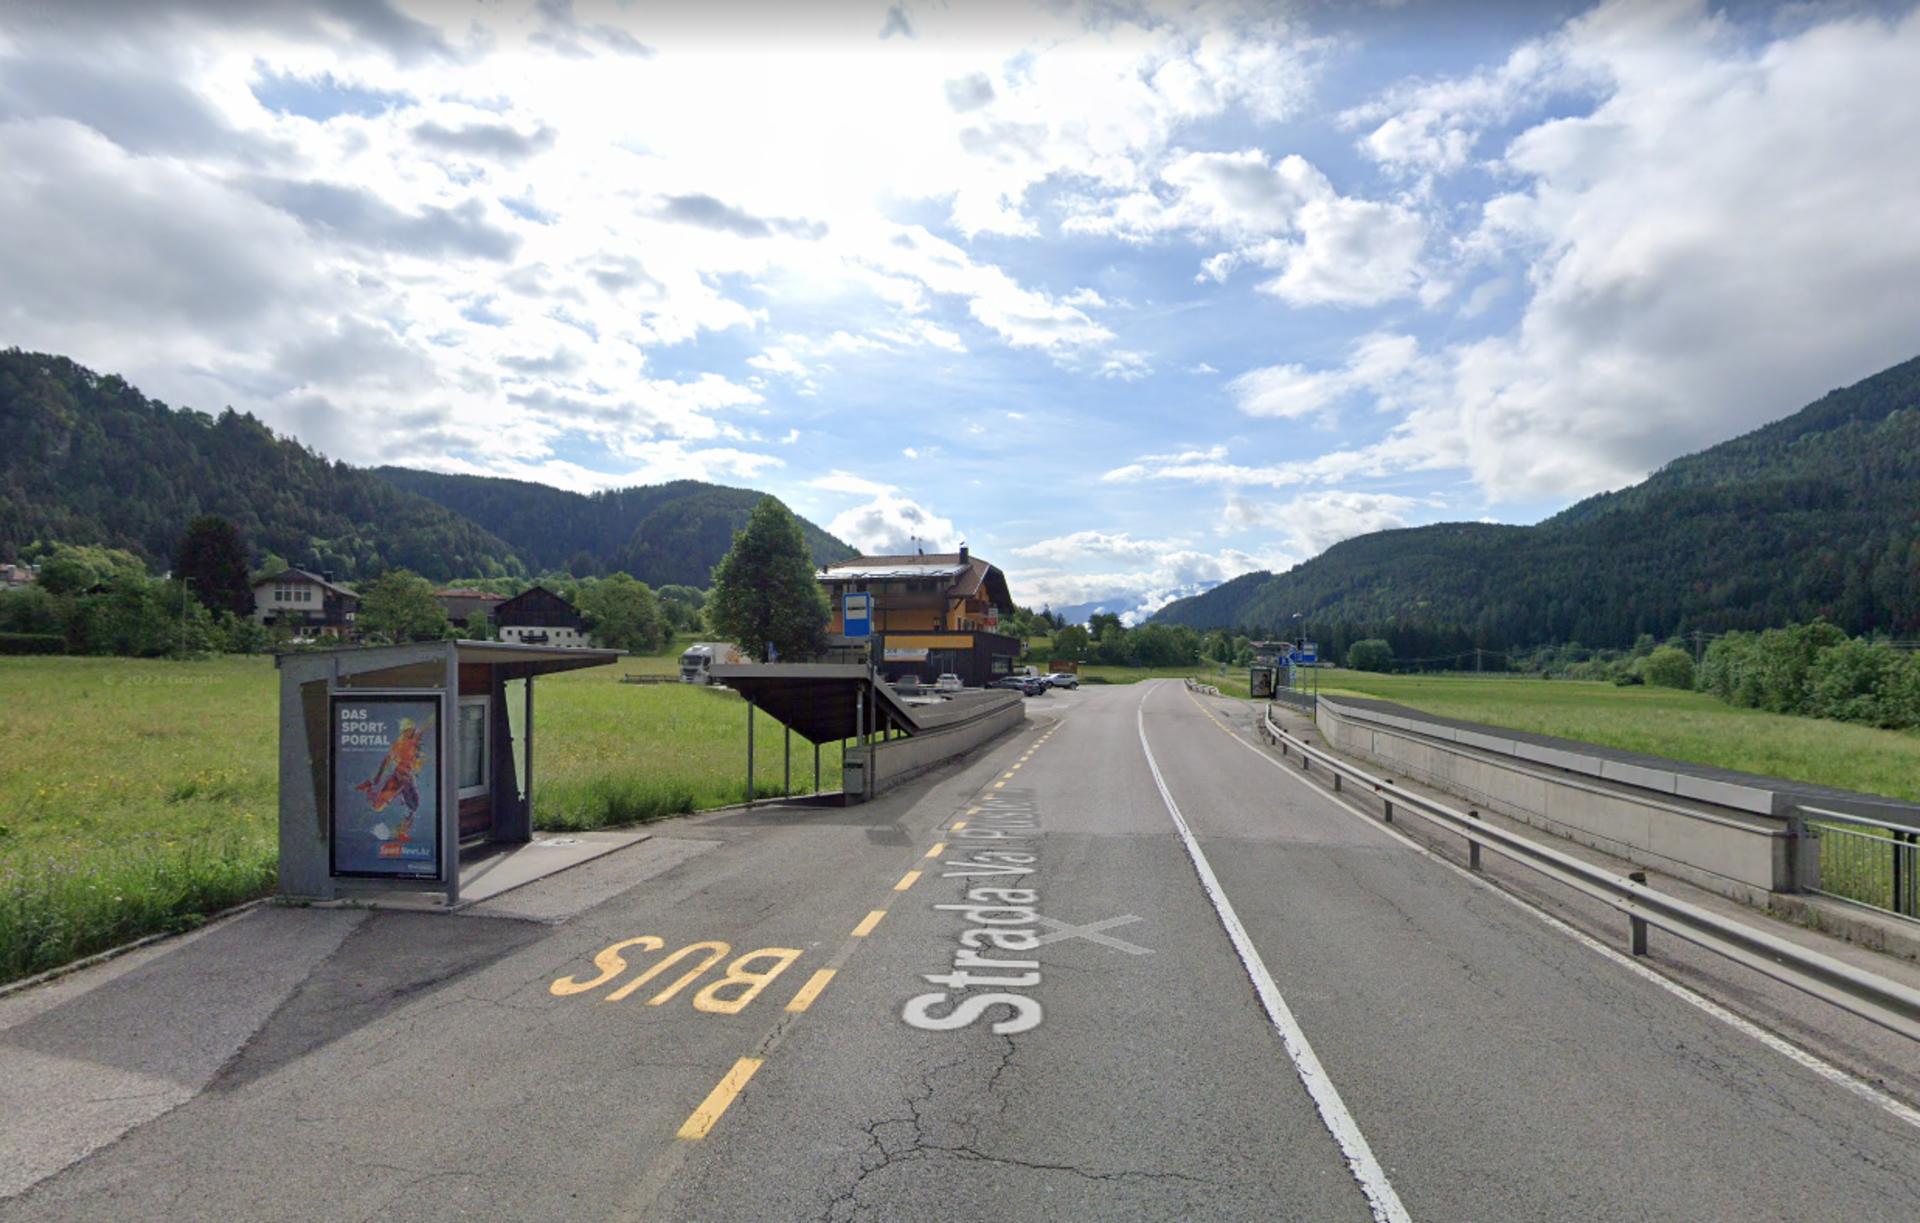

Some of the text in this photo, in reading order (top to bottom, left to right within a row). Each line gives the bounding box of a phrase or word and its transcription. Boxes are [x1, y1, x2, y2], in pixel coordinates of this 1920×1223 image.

[341, 709, 368, 720] DAS
[341, 722, 387, 732] SPORT-
[341, 734, 390, 745] PORTAL
[549, 935, 805, 1015] BUS
